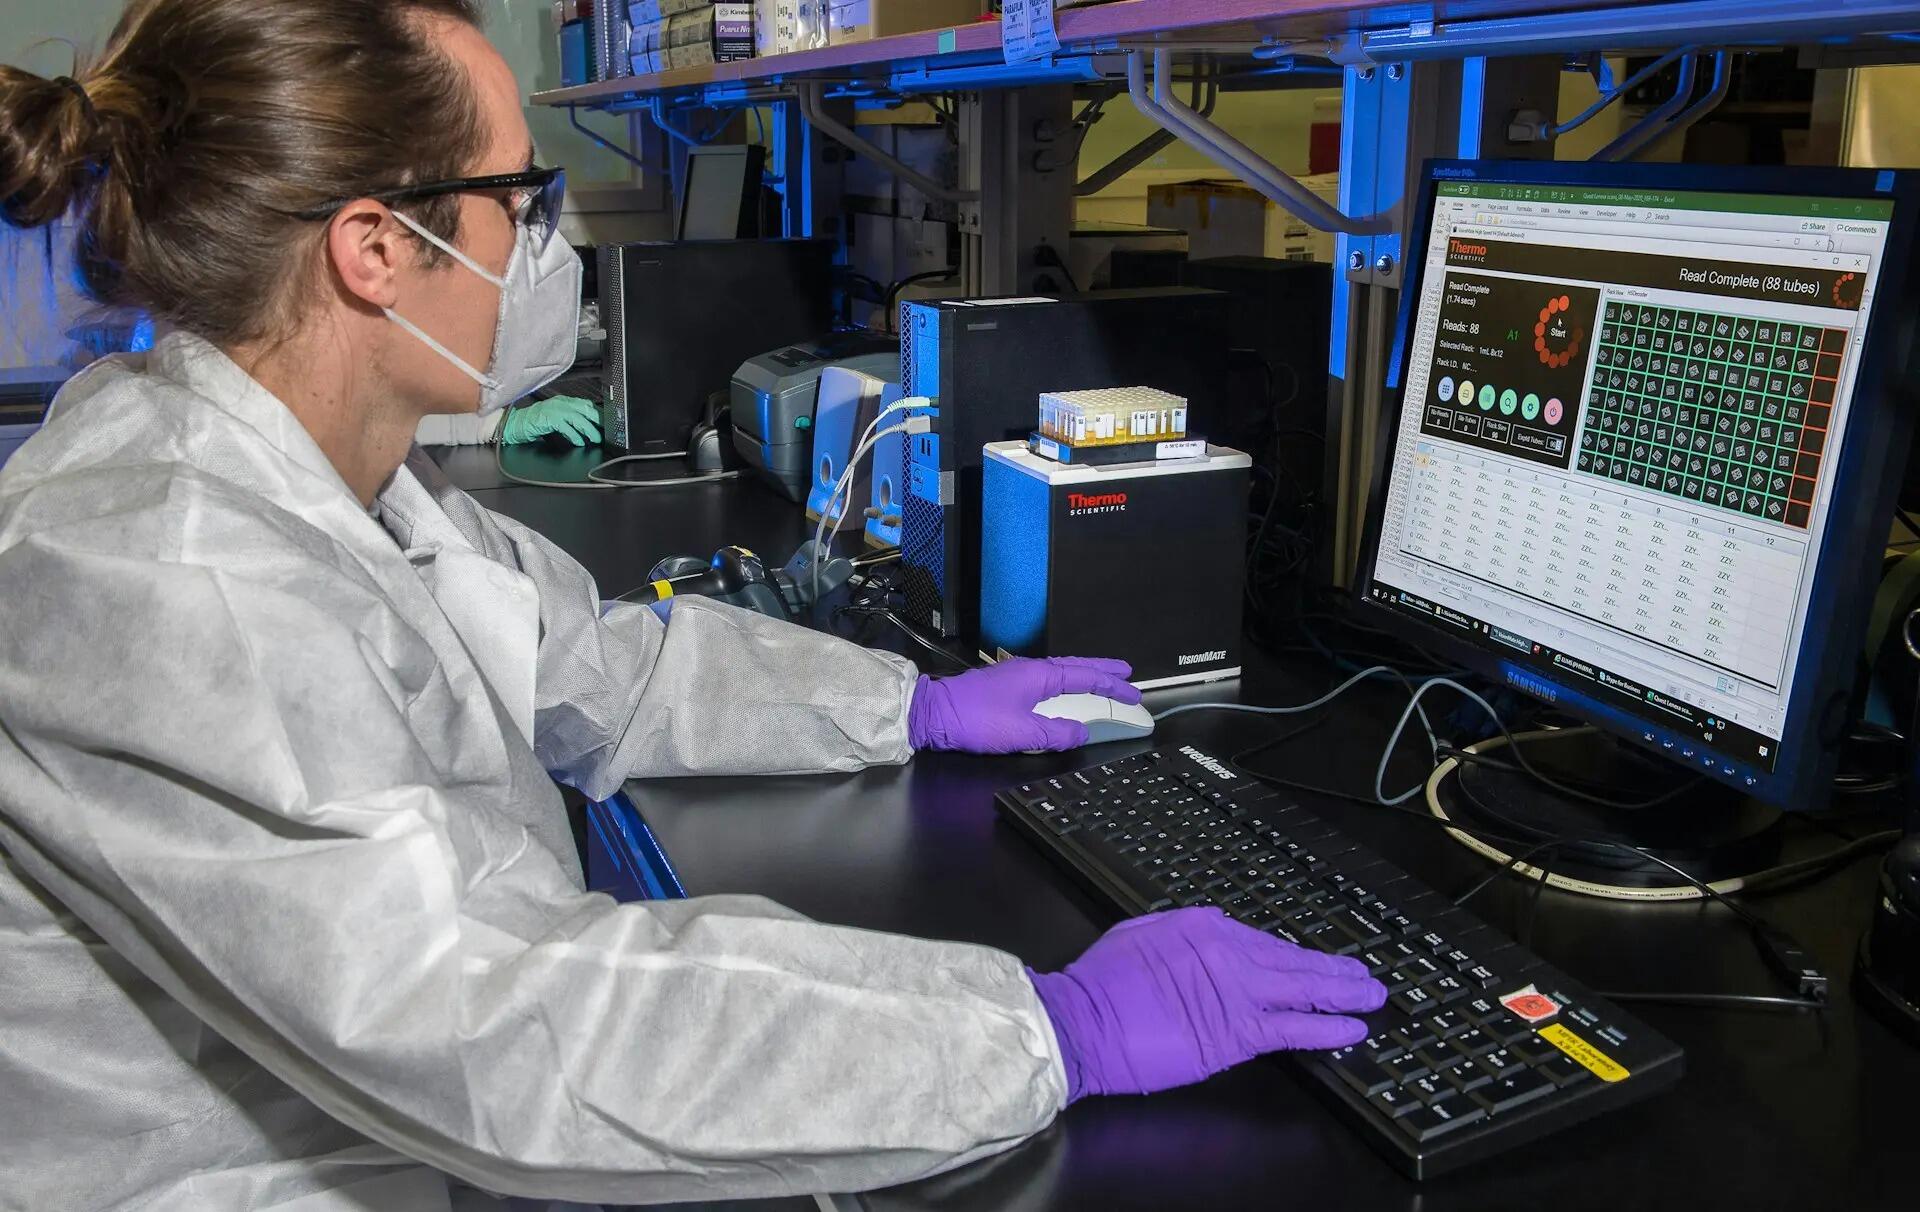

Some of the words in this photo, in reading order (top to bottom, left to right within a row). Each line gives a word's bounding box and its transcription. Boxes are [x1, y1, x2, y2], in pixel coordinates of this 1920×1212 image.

[1809, 222, 1826, 231] Share
[1844, 225, 1877, 234] Comments
[1450, 240, 1487, 256] Thermo
[1450, 253, 1485, 263] SCIENTIFIC
[1449, 281, 1463, 291] Read
[1464, 284, 1490, 295] Complete
[1679, 268, 1706, 283] Read
[1708, 271, 1760, 289] Complete
[1762, 276, 1782, 293] (88
[1783, 279, 1820, 297] tubes)
[1446, 295, 1461, 305] (1.74
[1460, 297, 1477, 308] secs)
[1442, 318, 1468, 333] Reads:
[1469, 322, 1480, 335] 88
[1507, 329, 1519, 341] A1
[1550, 327, 1566, 339] Start
[1439, 339, 1461, 351] Selected
[1461, 344, 1475, 353] Rack:
[1436, 357, 1449, 368] Rack
[1068, 491, 1128, 509] Thermo
[1070, 504, 1126, 516] SCIENTIFIC
[1691, 517, 1699, 525] 10
[1727, 527, 1735, 535] 11
[1766, 538, 1775, 546] 12
[1506, 671, 1557, 703] SAMSUNG
[1653, 694, 1667, 706] Quest
[1178, 745, 1238, 780] wetkeys
[1353, 887, 1367, 896] F10
[1374, 901, 1387, 910] F11
[1395, 915, 1410, 925] F12
